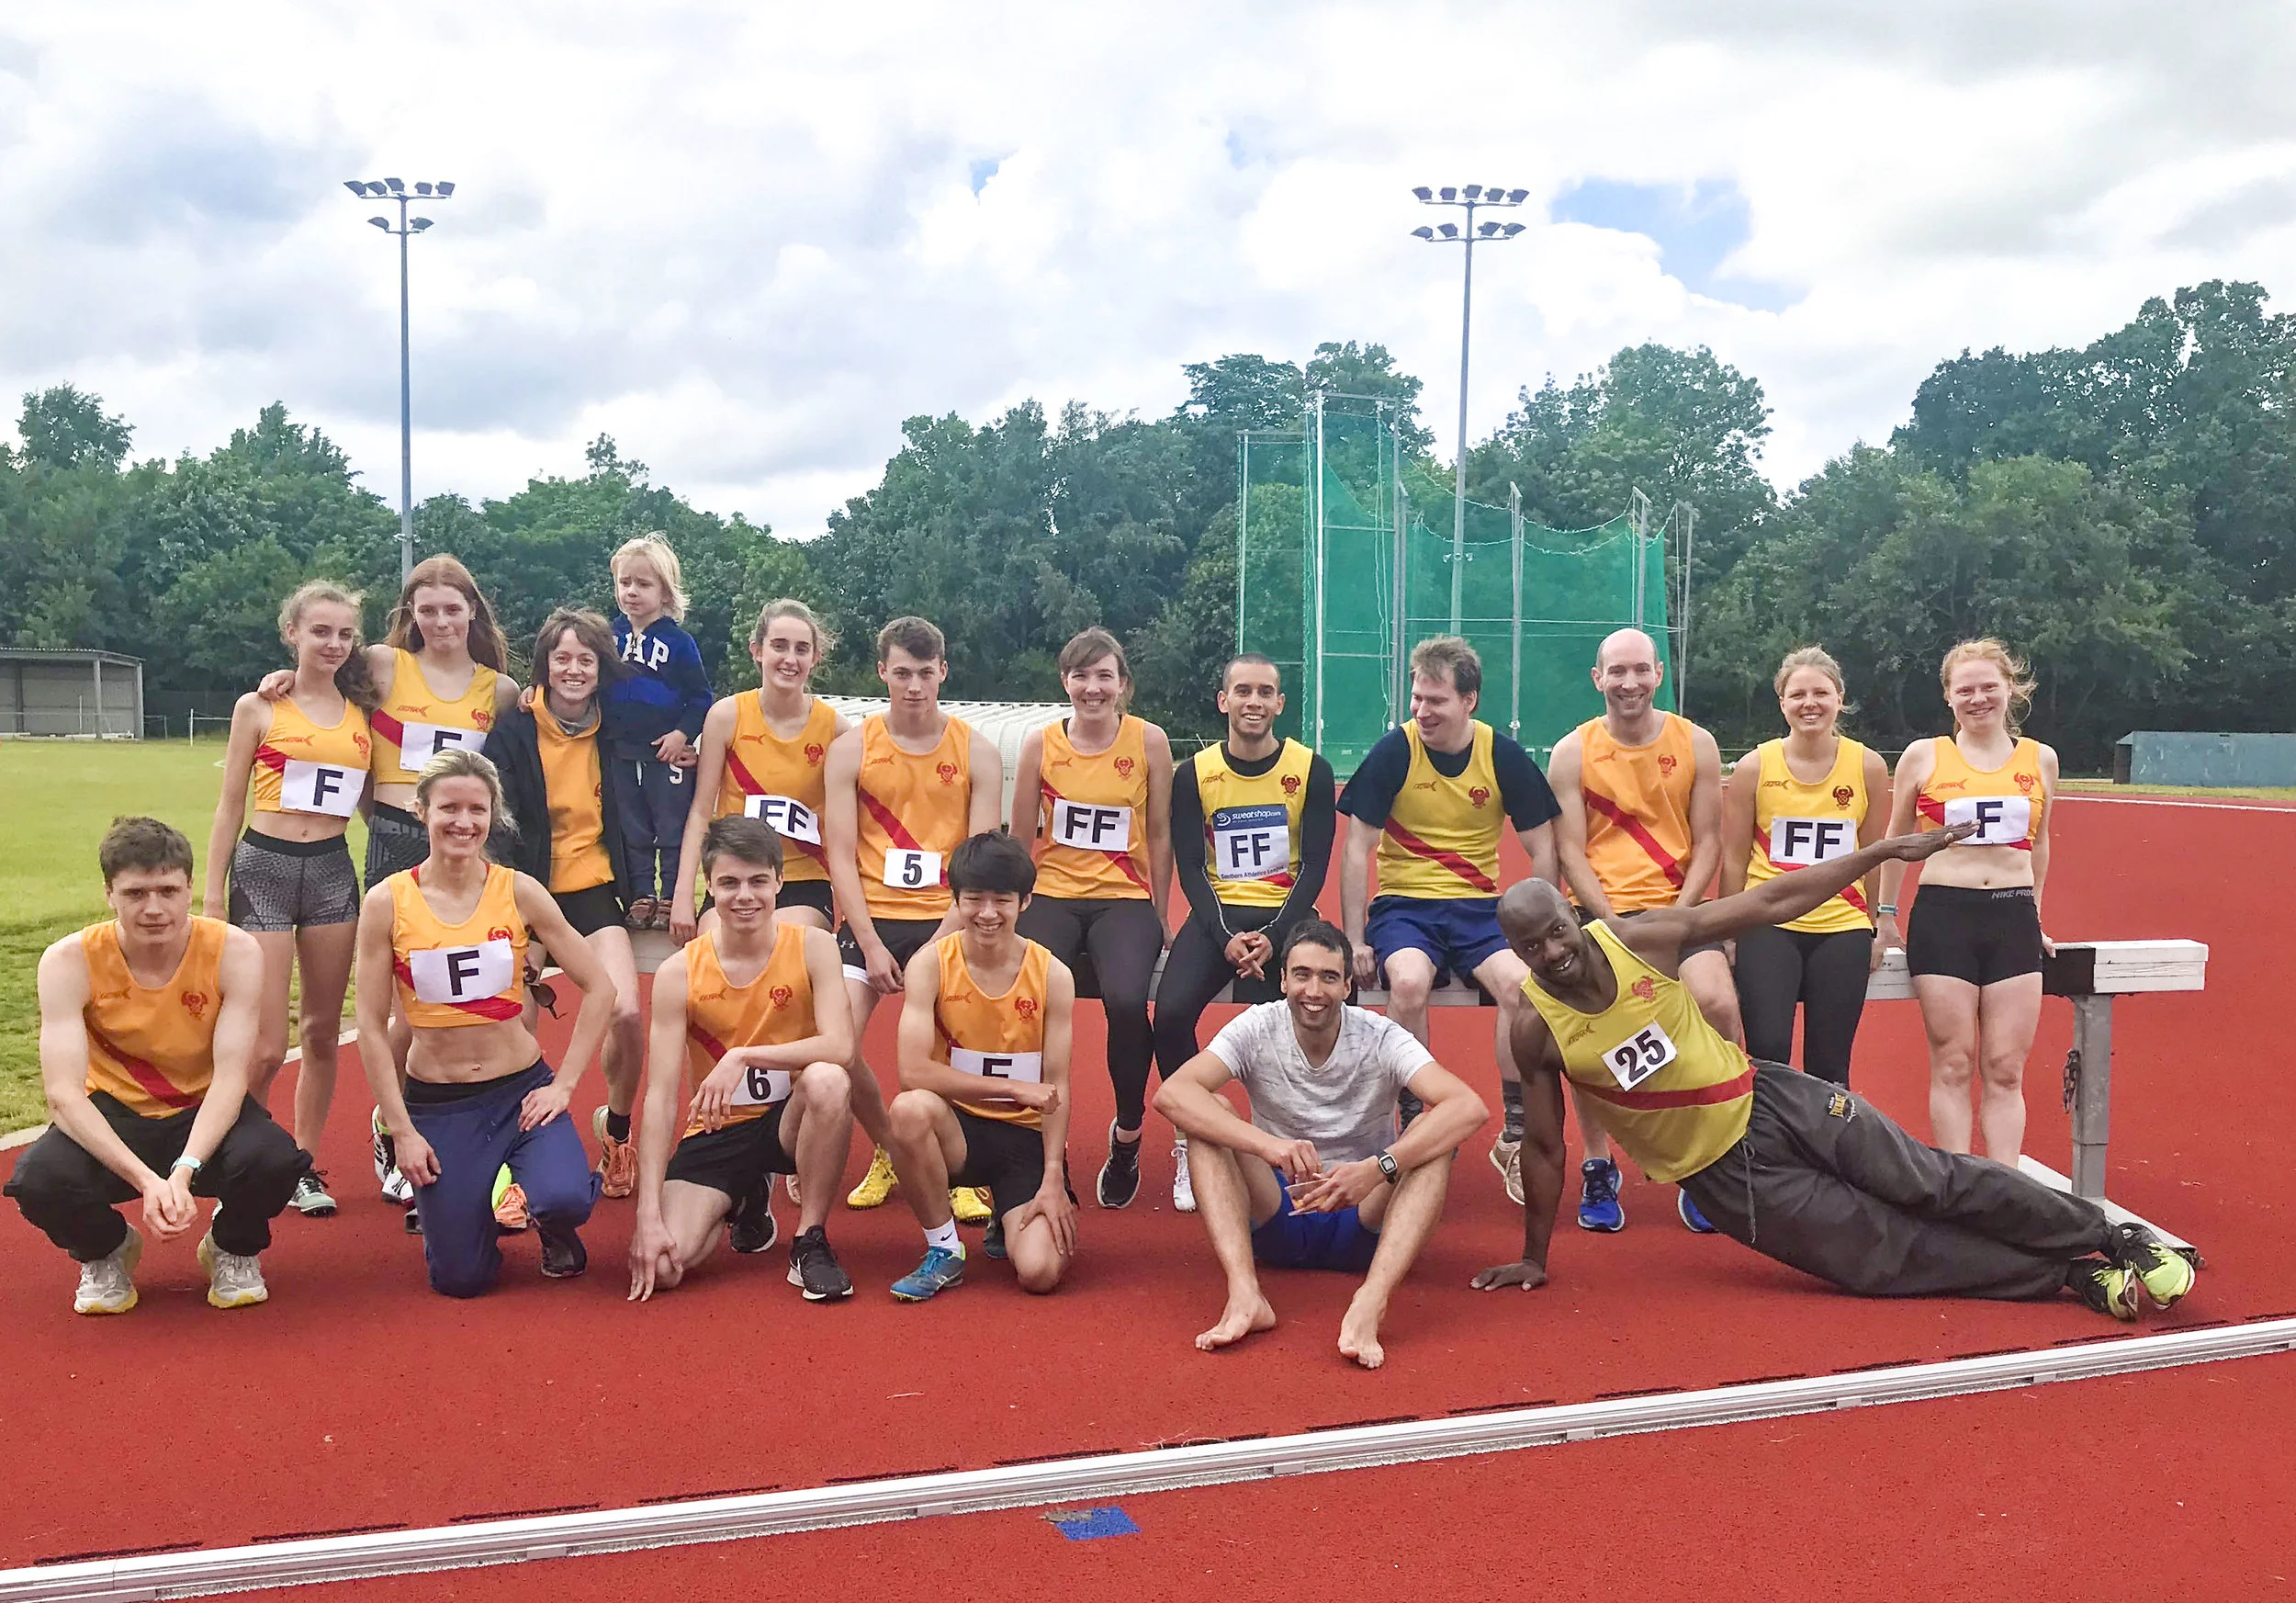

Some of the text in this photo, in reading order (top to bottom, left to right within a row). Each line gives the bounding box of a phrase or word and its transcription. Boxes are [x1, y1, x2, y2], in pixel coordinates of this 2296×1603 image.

[613, 632, 670, 672] AP
[313, 768, 343, 807] F
[760, 799, 809, 833] FF
[1065, 806, 1120, 843] FF
[1975, 801, 2003, 838] F
[1230, 832, 1270, 868] FF
[1784, 820, 1843, 859] FF
[902, 853, 922, 886] 5
[446, 950, 480, 996] F
[1615, 1029, 1666, 1083] 25
[747, 1066, 771, 1101] 6
